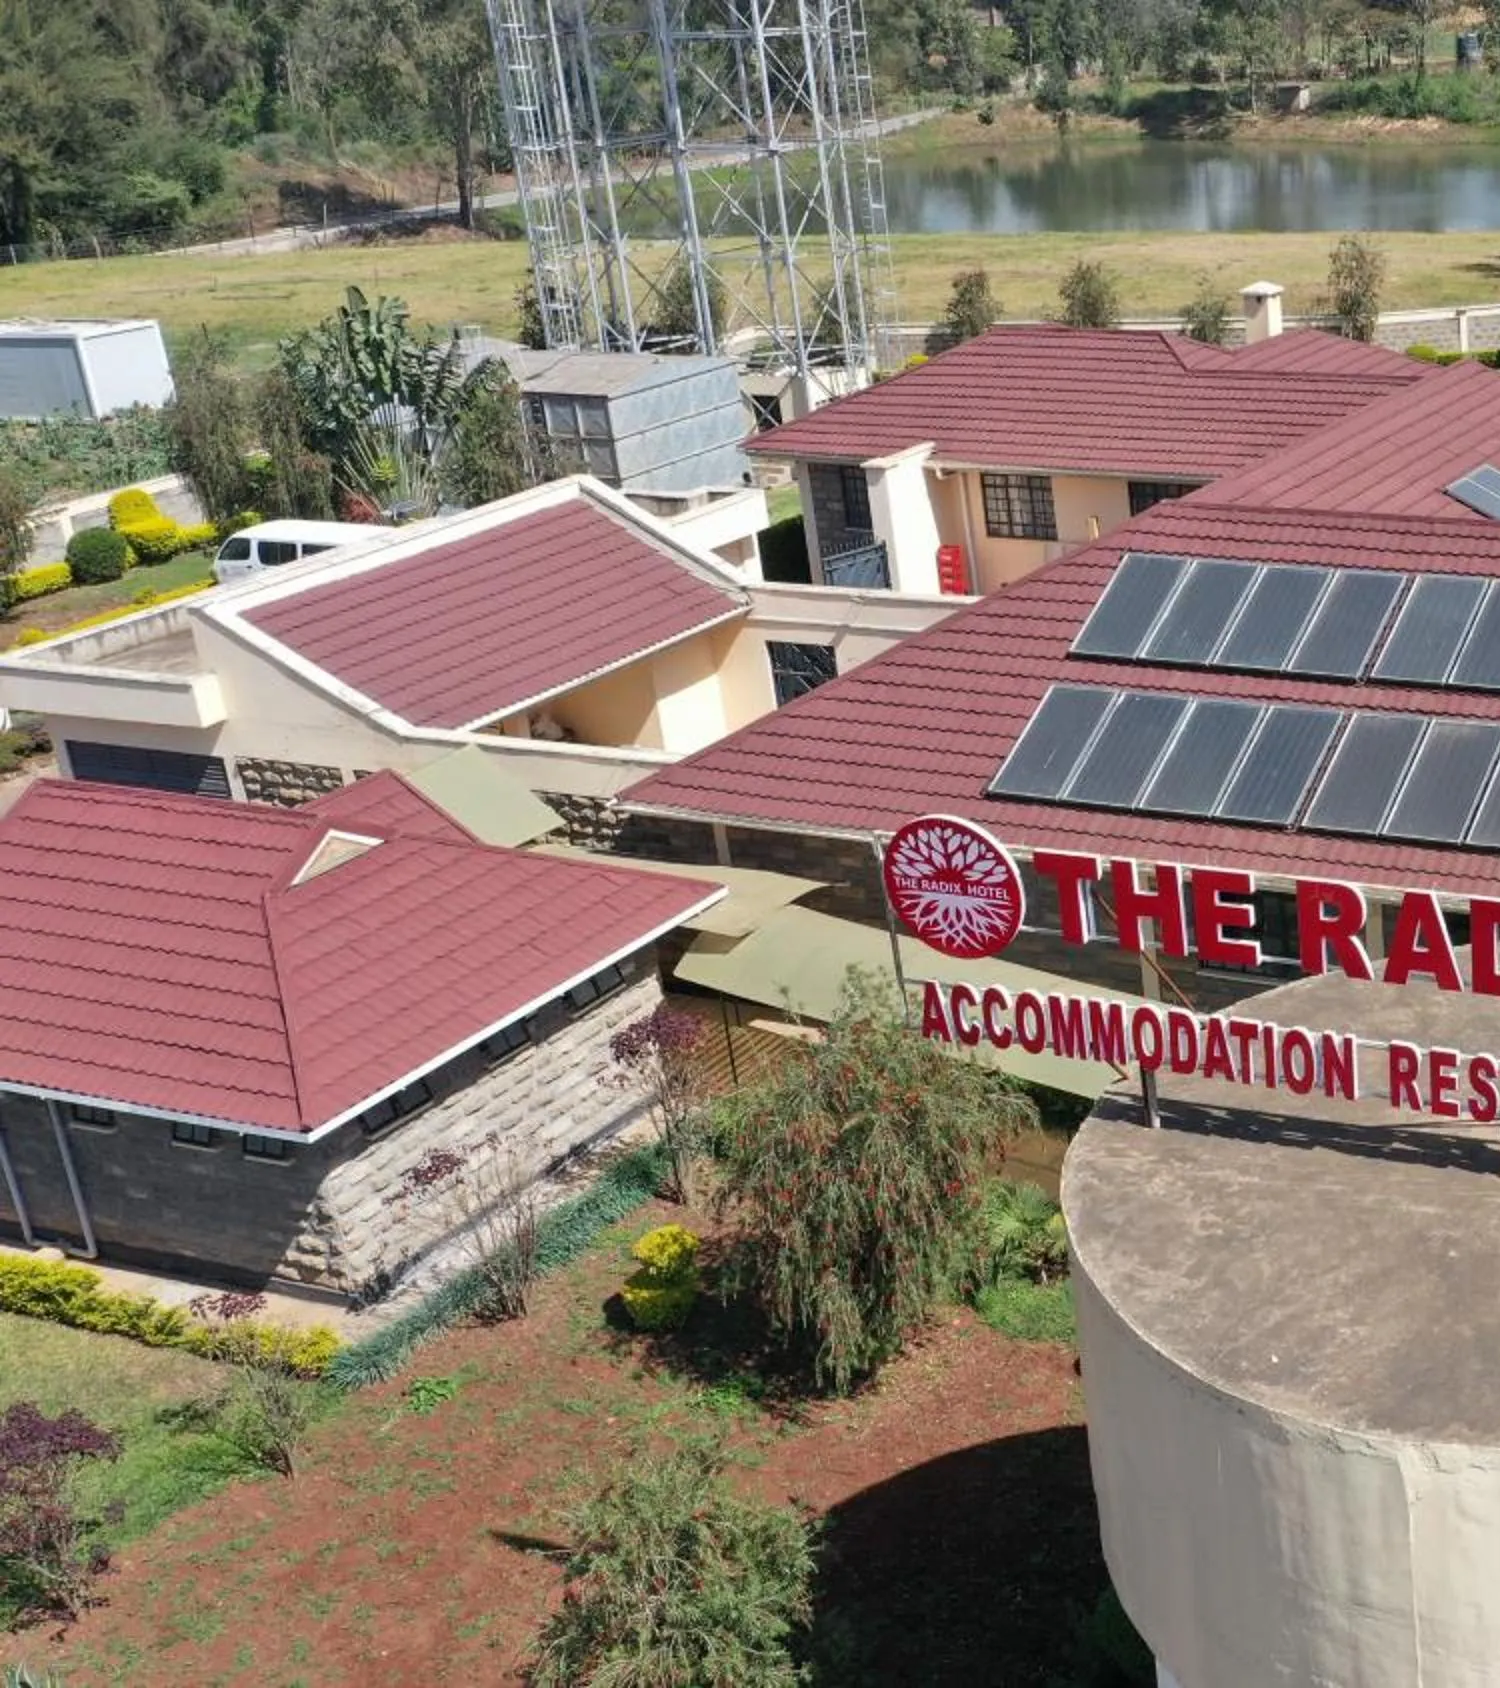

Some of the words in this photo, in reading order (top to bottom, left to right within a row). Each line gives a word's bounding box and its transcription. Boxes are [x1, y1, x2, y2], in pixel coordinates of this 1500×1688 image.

[894, 876, 919, 889] THE
[921, 880, 962, 894] RADIX
[967, 885, 1010, 900] HOTEL
[1033, 849, 1264, 968] THE
[921, 979, 1358, 1100] ACCOMMODATION
